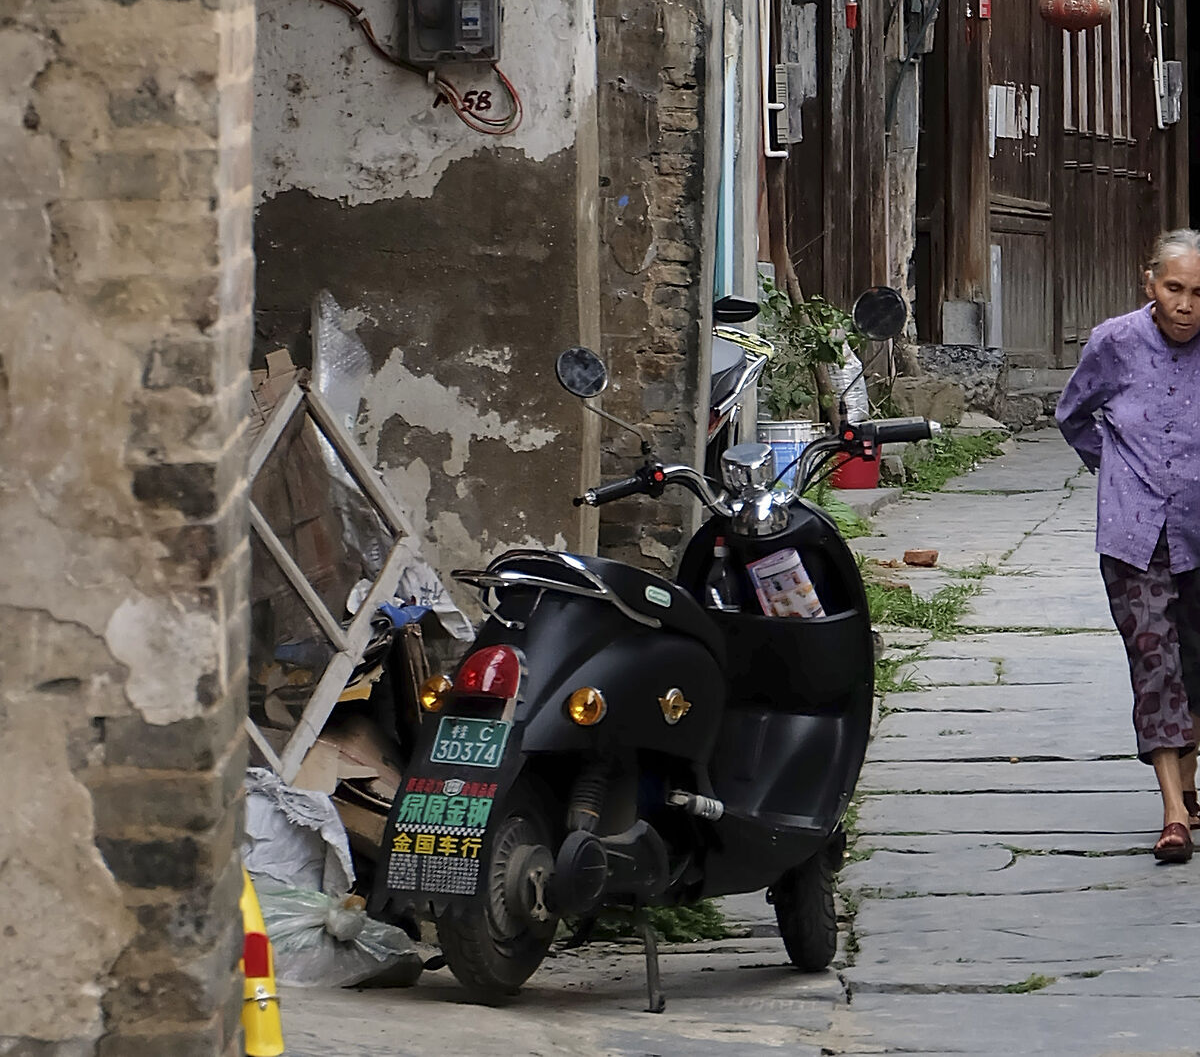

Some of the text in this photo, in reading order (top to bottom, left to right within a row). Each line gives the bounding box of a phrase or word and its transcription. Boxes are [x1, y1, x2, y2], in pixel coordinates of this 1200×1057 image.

[451, 725, 494, 741] 桂 C
[436, 739, 498, 763] 3D374
[391, 832, 482, 858] 金国车行
